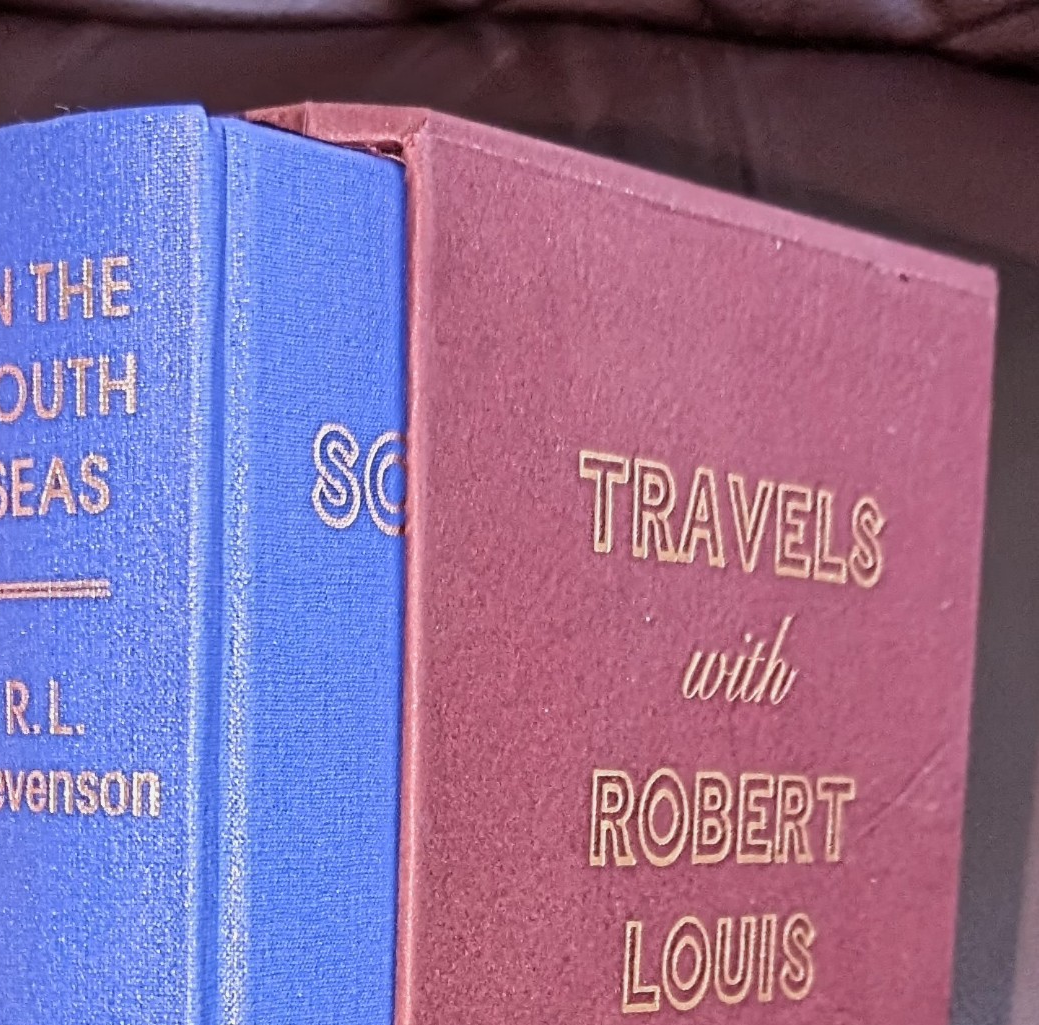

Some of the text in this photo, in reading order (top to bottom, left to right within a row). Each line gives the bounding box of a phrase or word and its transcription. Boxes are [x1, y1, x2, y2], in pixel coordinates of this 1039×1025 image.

[29, 255, 131, 322] THE
[578, 449, 886, 588] TRAVELS
[681, 615, 798, 706] with
[589, 767, 856, 867] ROBERT
[621, 912, 816, 1014] LOUIS
